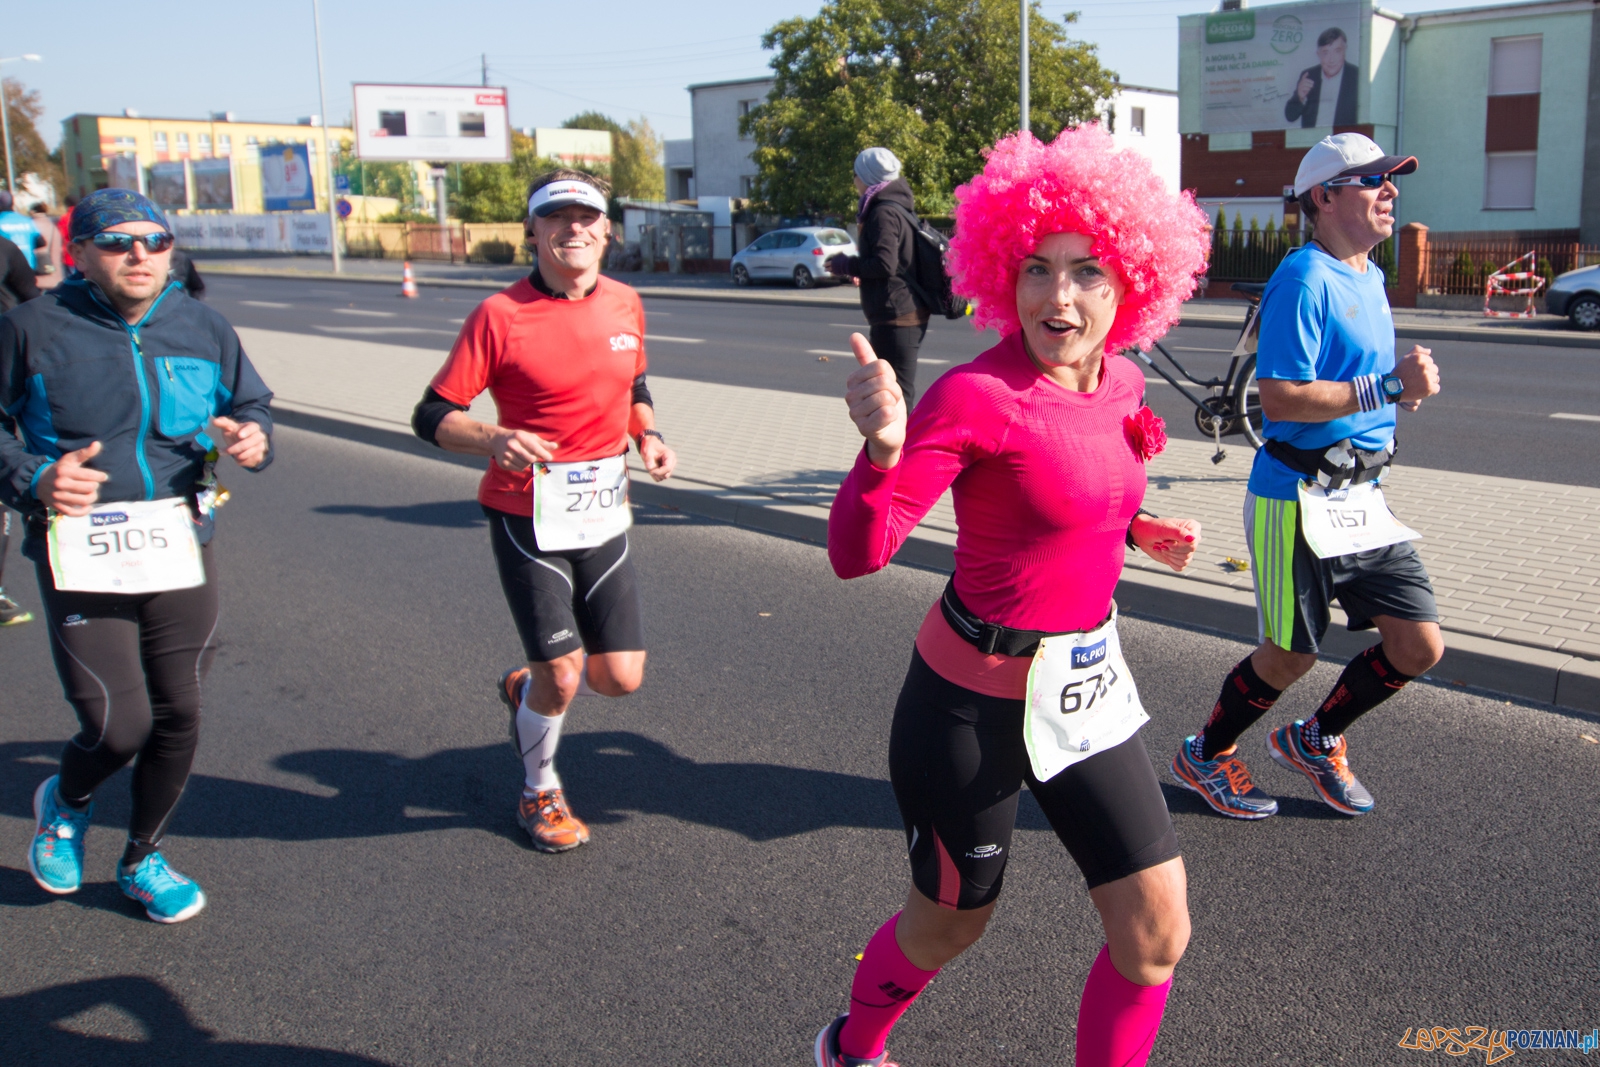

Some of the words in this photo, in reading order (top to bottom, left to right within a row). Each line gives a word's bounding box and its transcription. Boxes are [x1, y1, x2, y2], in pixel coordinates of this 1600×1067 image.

[1271, 29, 1303, 44] ZERO
[1205, 64, 1216, 73] NIE
[1217, 63, 1228, 72] MA
[1229, 62, 1241, 70] NIC
[1242, 61, 1251, 69] ZA
[1326, 508, 1367, 528] 1157
[87, 527, 168, 556] 5106
[1074, 645, 1105, 663] 16.PKO
